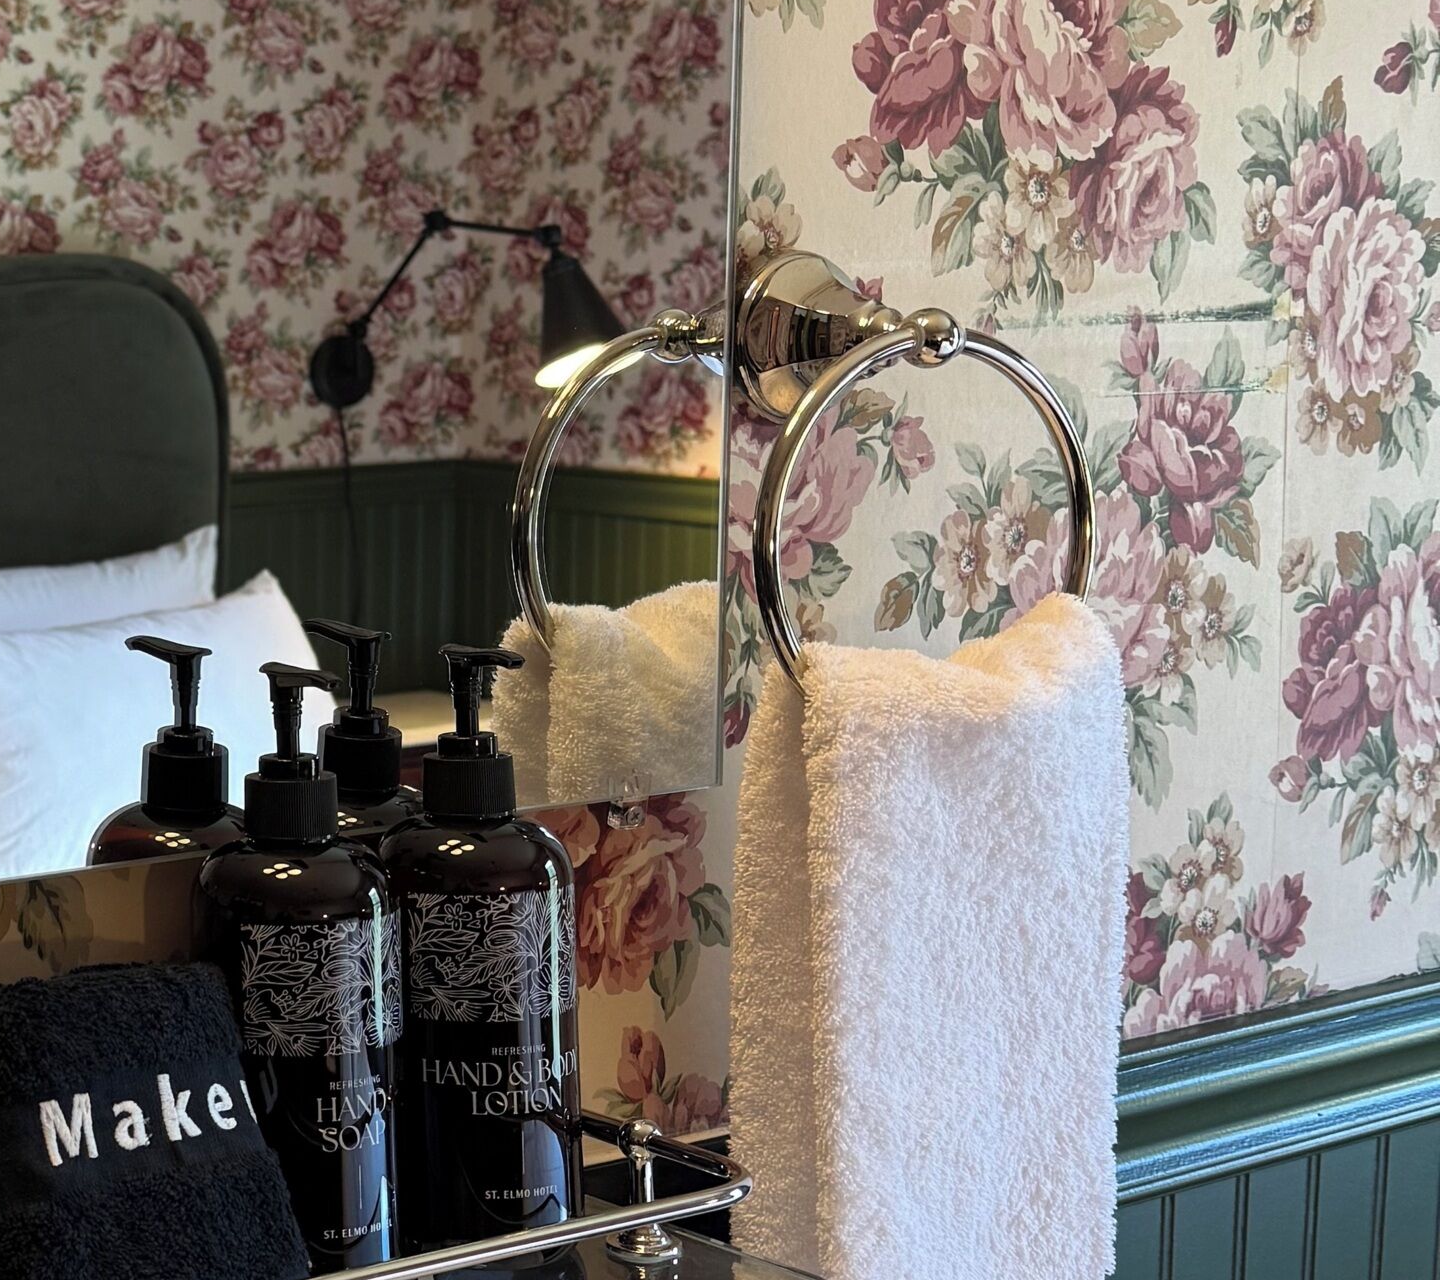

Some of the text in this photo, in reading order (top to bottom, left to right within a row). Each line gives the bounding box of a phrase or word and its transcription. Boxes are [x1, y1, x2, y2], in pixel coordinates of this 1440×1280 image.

[491, 1043, 547, 1056] REFRESHING
[329, 1074, 381, 1091] REFRESHING
[421, 1058, 504, 1087] HAND
[508, 1060, 533, 1086] &
[316, 1087, 387, 1123] HAND
[471, 1086, 563, 1116] LOTION
[39, 1073, 257, 1167] Make
[318, 1121, 386, 1153] SOAP
[485, 1185, 558, 1200] ST. ELMO HOTEL
[323, 1229, 338, 1240] ST.
[341, 1226, 368, 1238] ELMO
